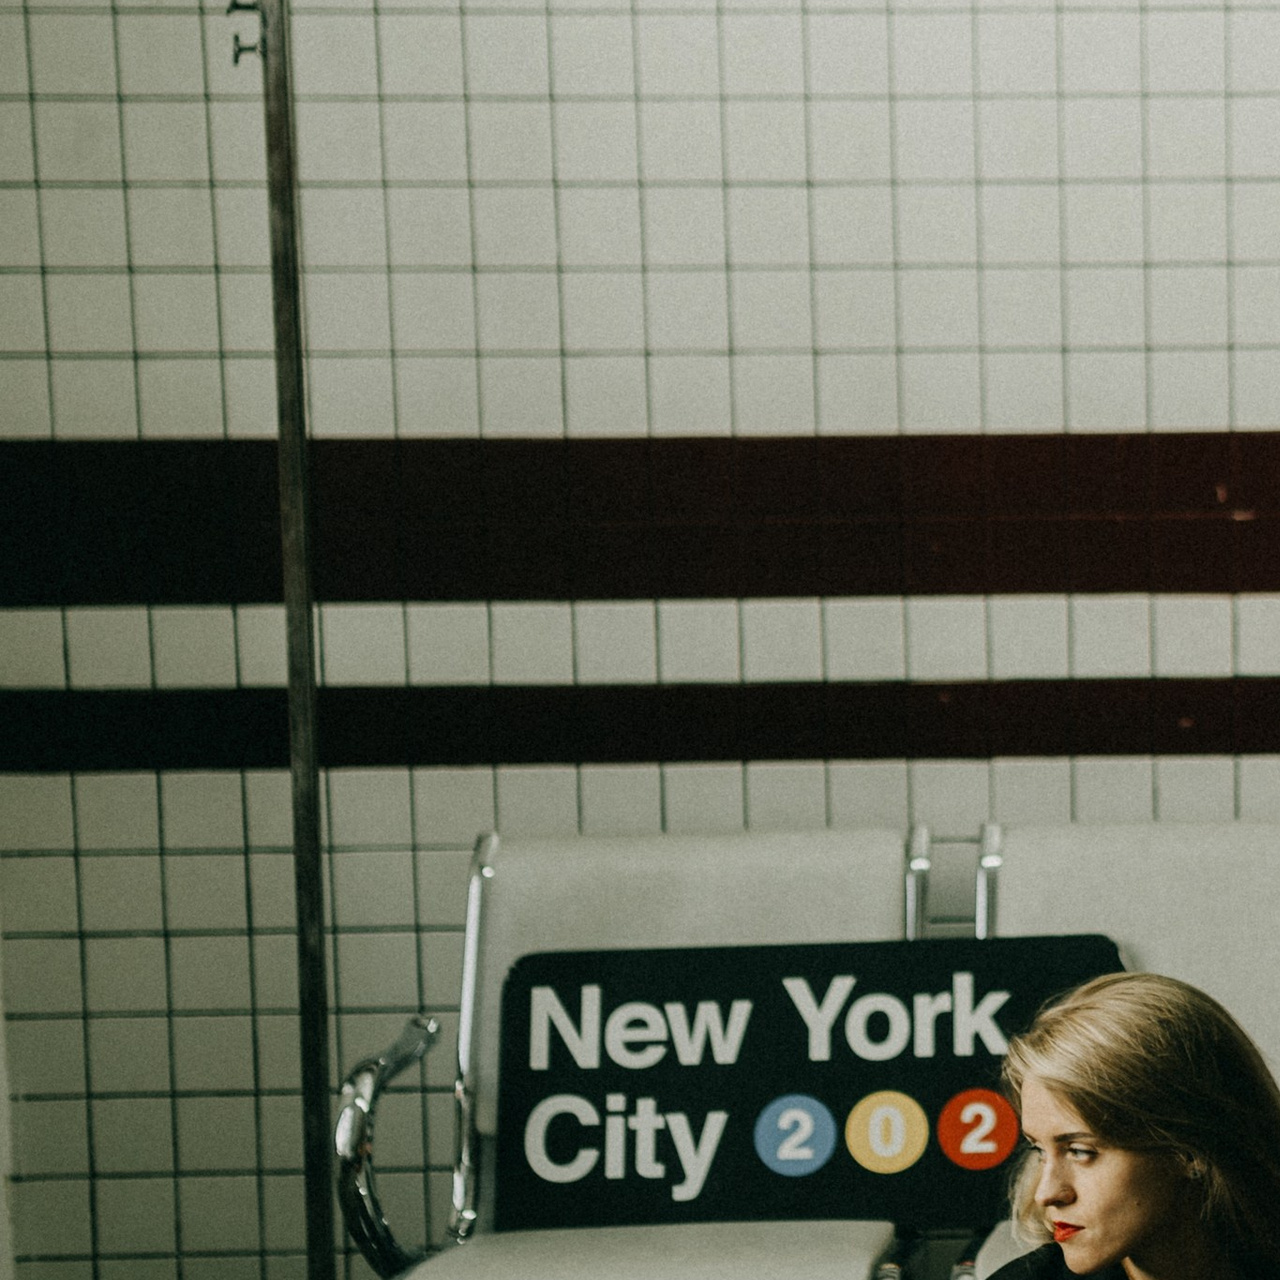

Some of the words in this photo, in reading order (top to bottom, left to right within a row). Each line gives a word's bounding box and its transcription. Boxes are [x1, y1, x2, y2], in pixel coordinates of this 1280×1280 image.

[529, 983, 754, 1071] New
[782, 971, 1012, 1062] York
[523, 1091, 729, 1203] City
